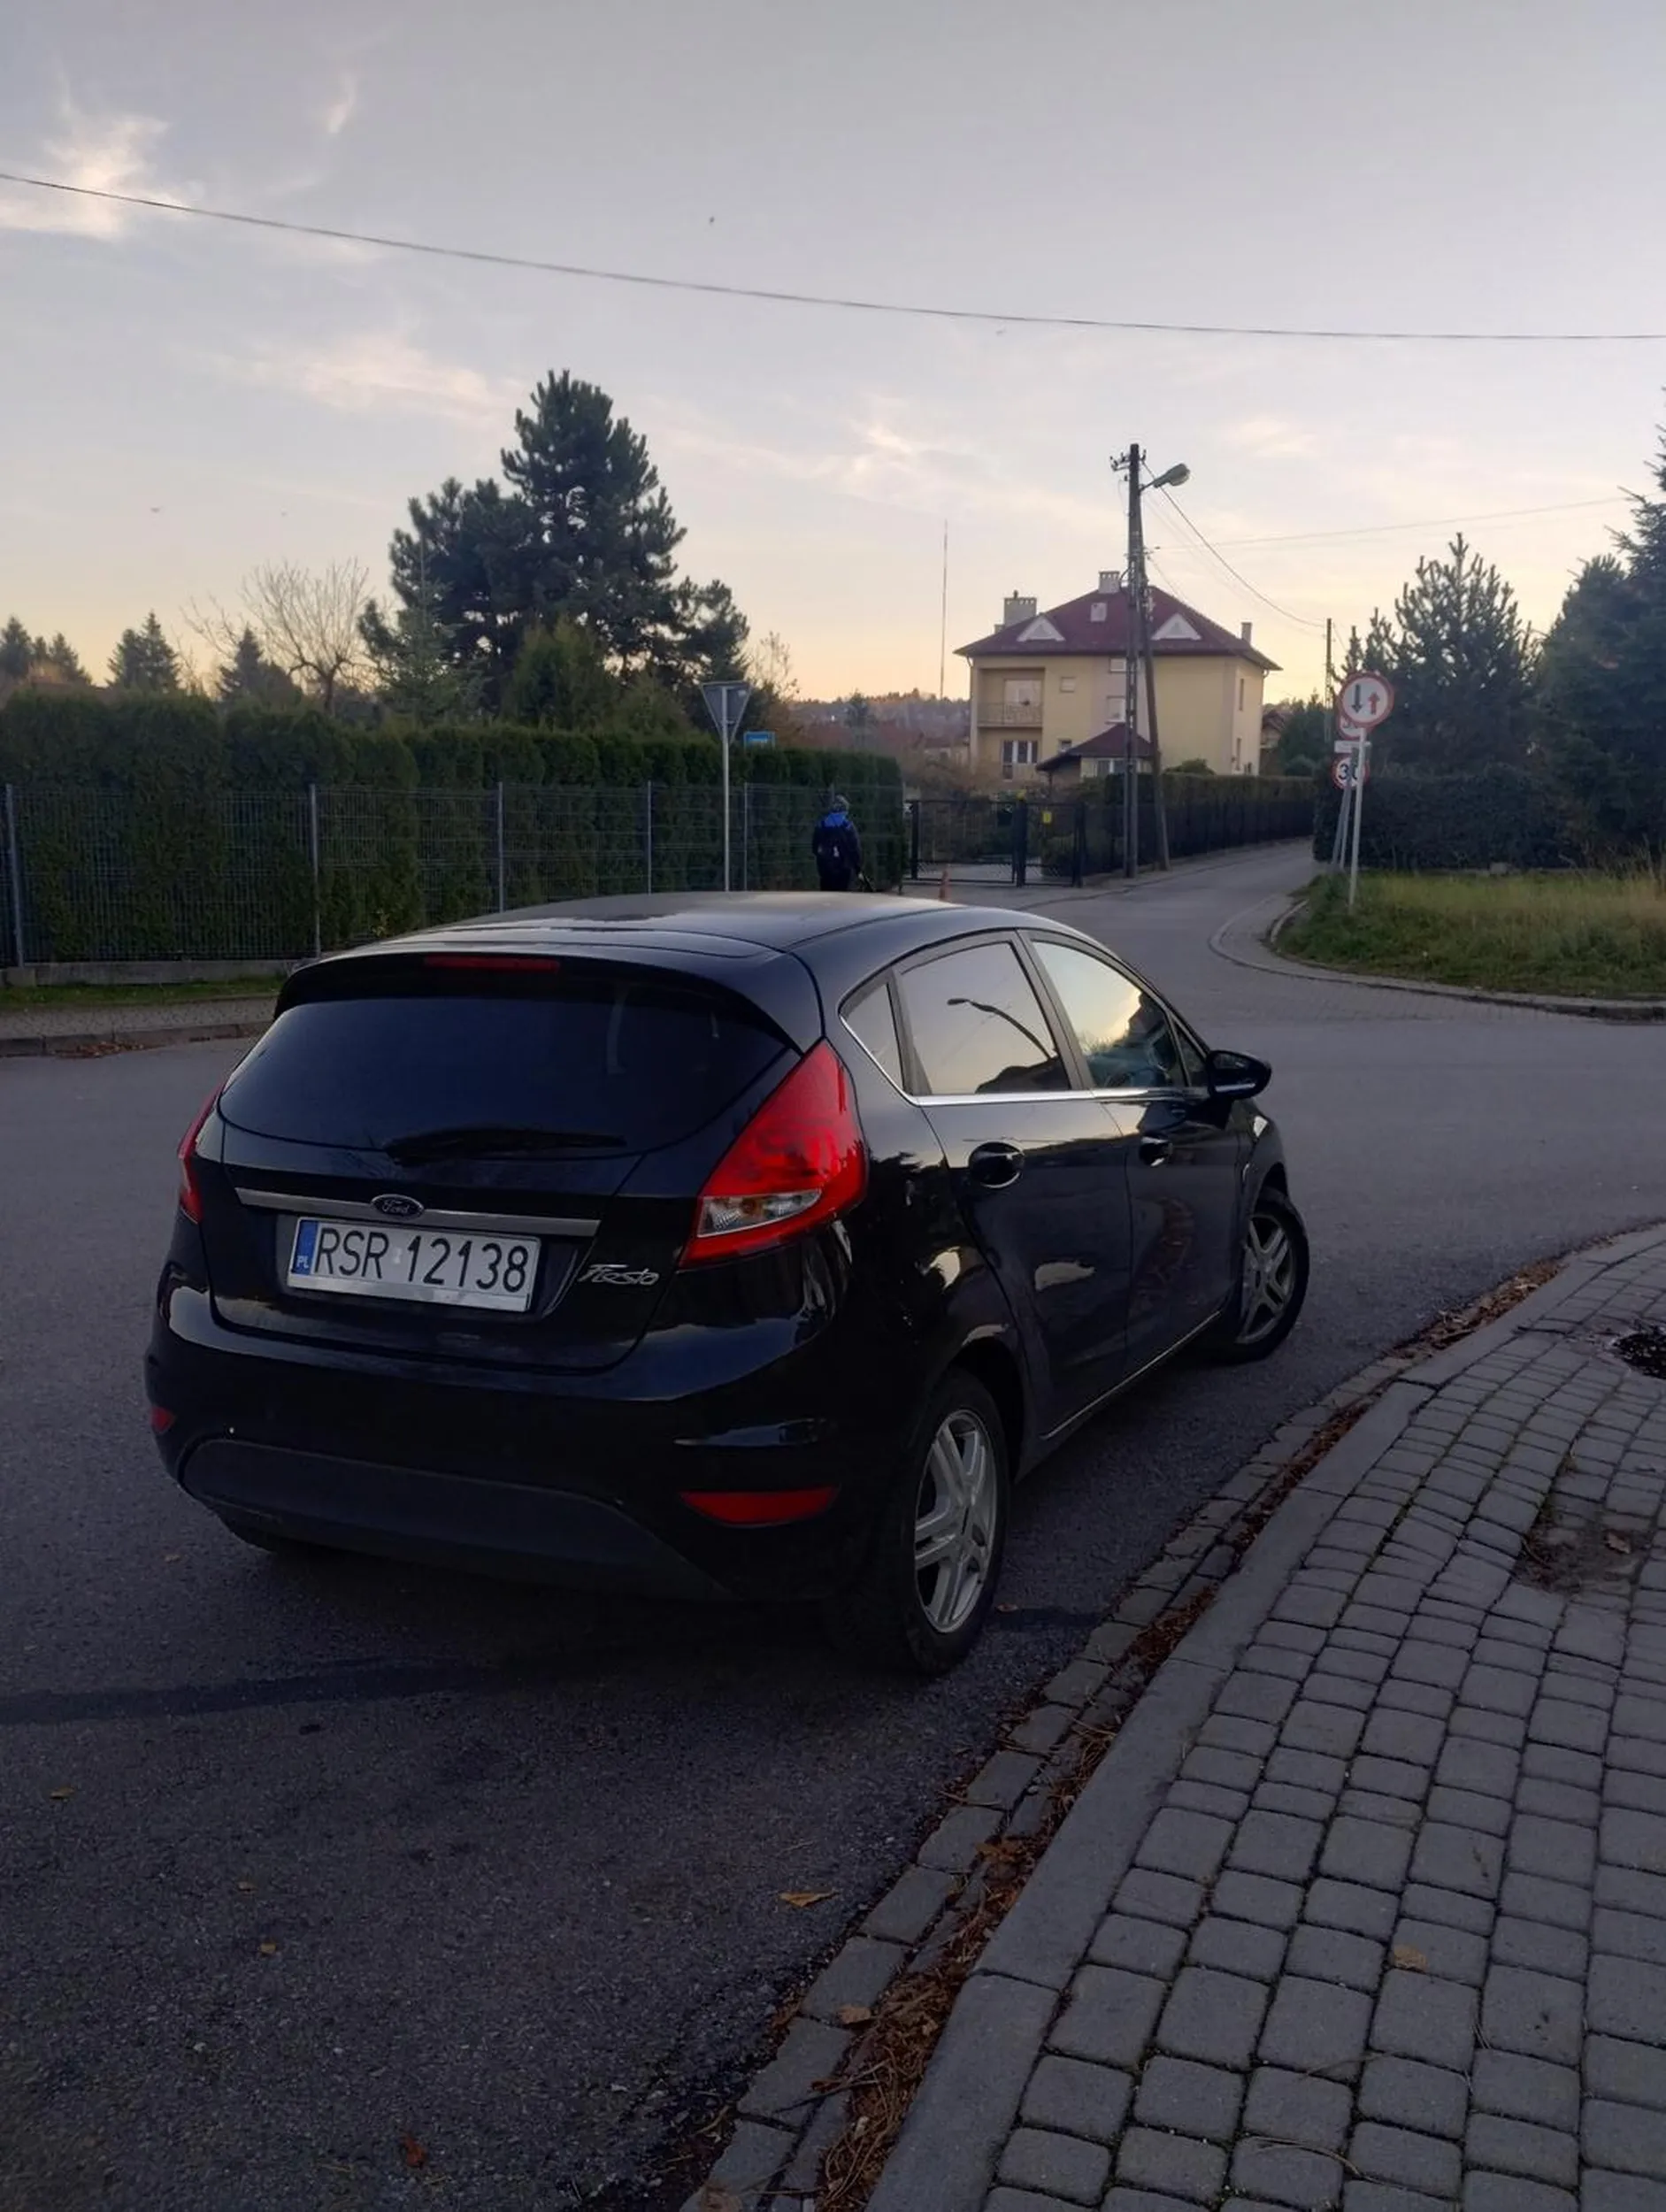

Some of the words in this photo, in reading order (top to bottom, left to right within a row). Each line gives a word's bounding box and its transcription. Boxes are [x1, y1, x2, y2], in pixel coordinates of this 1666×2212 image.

[296, 1255, 310, 1269] PL
[315, 1227, 389, 1279] RSR
[407, 1235, 528, 1293] 12138
[577, 1263, 660, 1286] Fiesta
